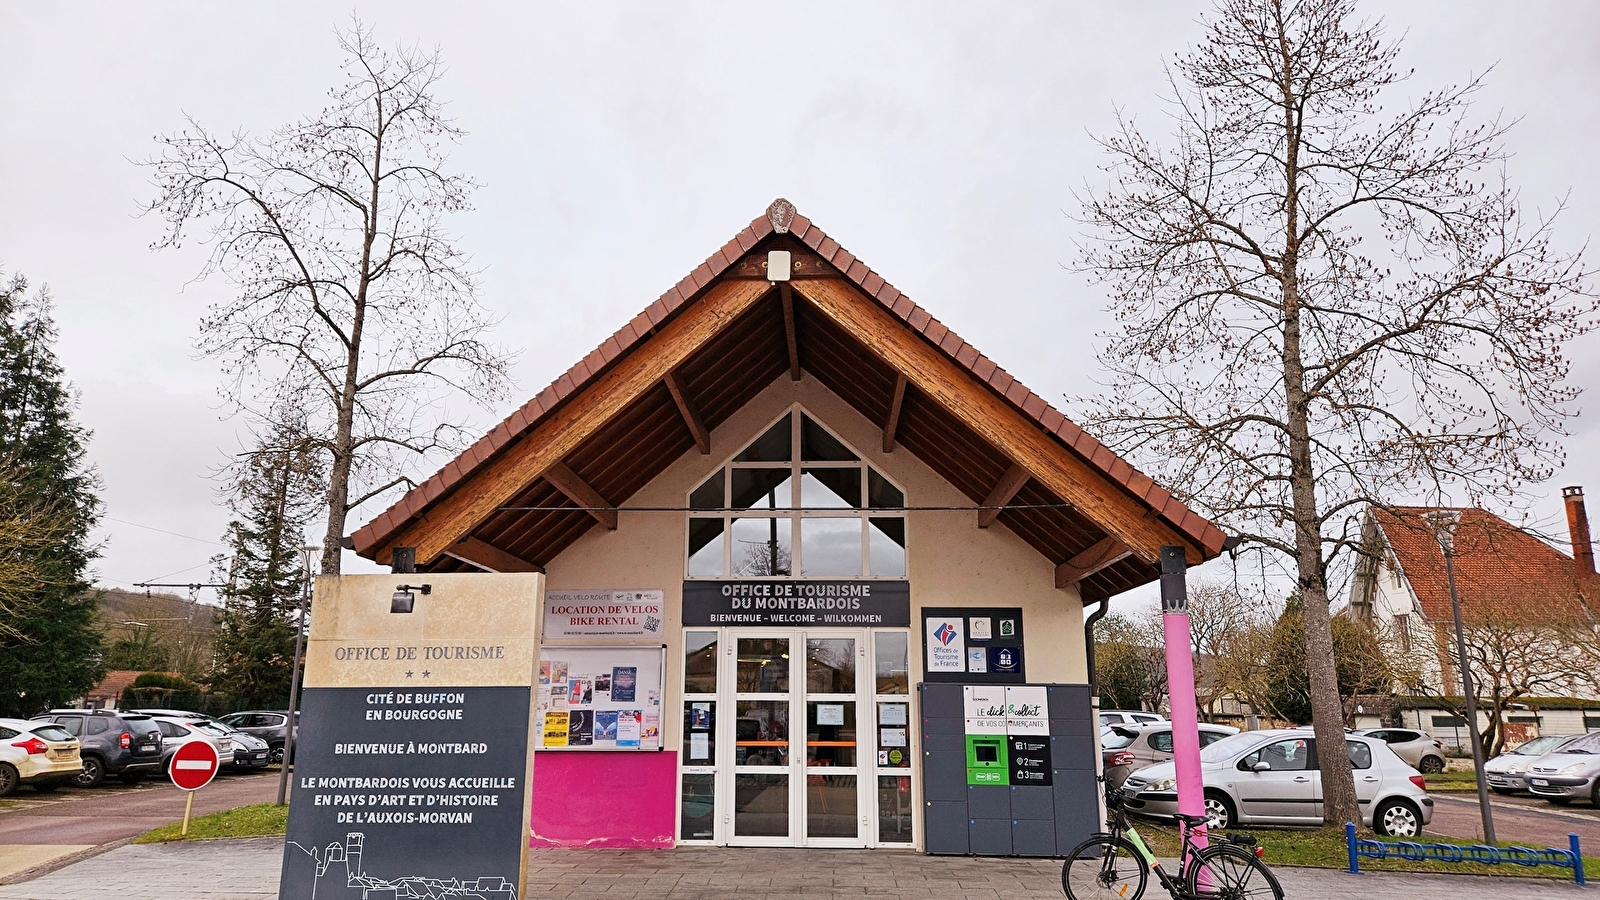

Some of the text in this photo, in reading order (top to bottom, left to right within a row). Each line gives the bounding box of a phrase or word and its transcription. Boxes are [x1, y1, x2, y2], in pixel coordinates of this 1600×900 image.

[722, 584, 871, 597] OFFICE DE TOURISME
[551, 605, 659, 614] LOCATION DE VELOS
[732, 598, 861, 610] DU MONTBARDOIS
[570, 616, 640, 626] BIKE RENTAL
[710, 614, 762, 622] BIENVENUE
[770, 614, 816, 622] WELCOME
[824, 614, 882, 623] WILKOMMEN
[334, 646, 505, 660] OFFICE DE TOURISME
[366, 692, 464, 704] CITÉ DE BUFFON
[365, 709, 463, 720] EN BOURGOGNE
[976, 704, 1042, 717] LE click & collect
[334, 740, 488, 754] BIENVENUE À MONTBARD
[1024, 742, 1027, 750] 1
[1024, 758, 1029, 766] 2
[1025, 770, 1030, 779] 3
[301, 777, 516, 789] LE MONTBARDOIS VOUS ACCUEILLE
[314, 794, 498, 806] EN PAYS D’ART ET D’HISTOIRE
[336, 812, 473, 824] DE L’AUXOIS-MORVAN
